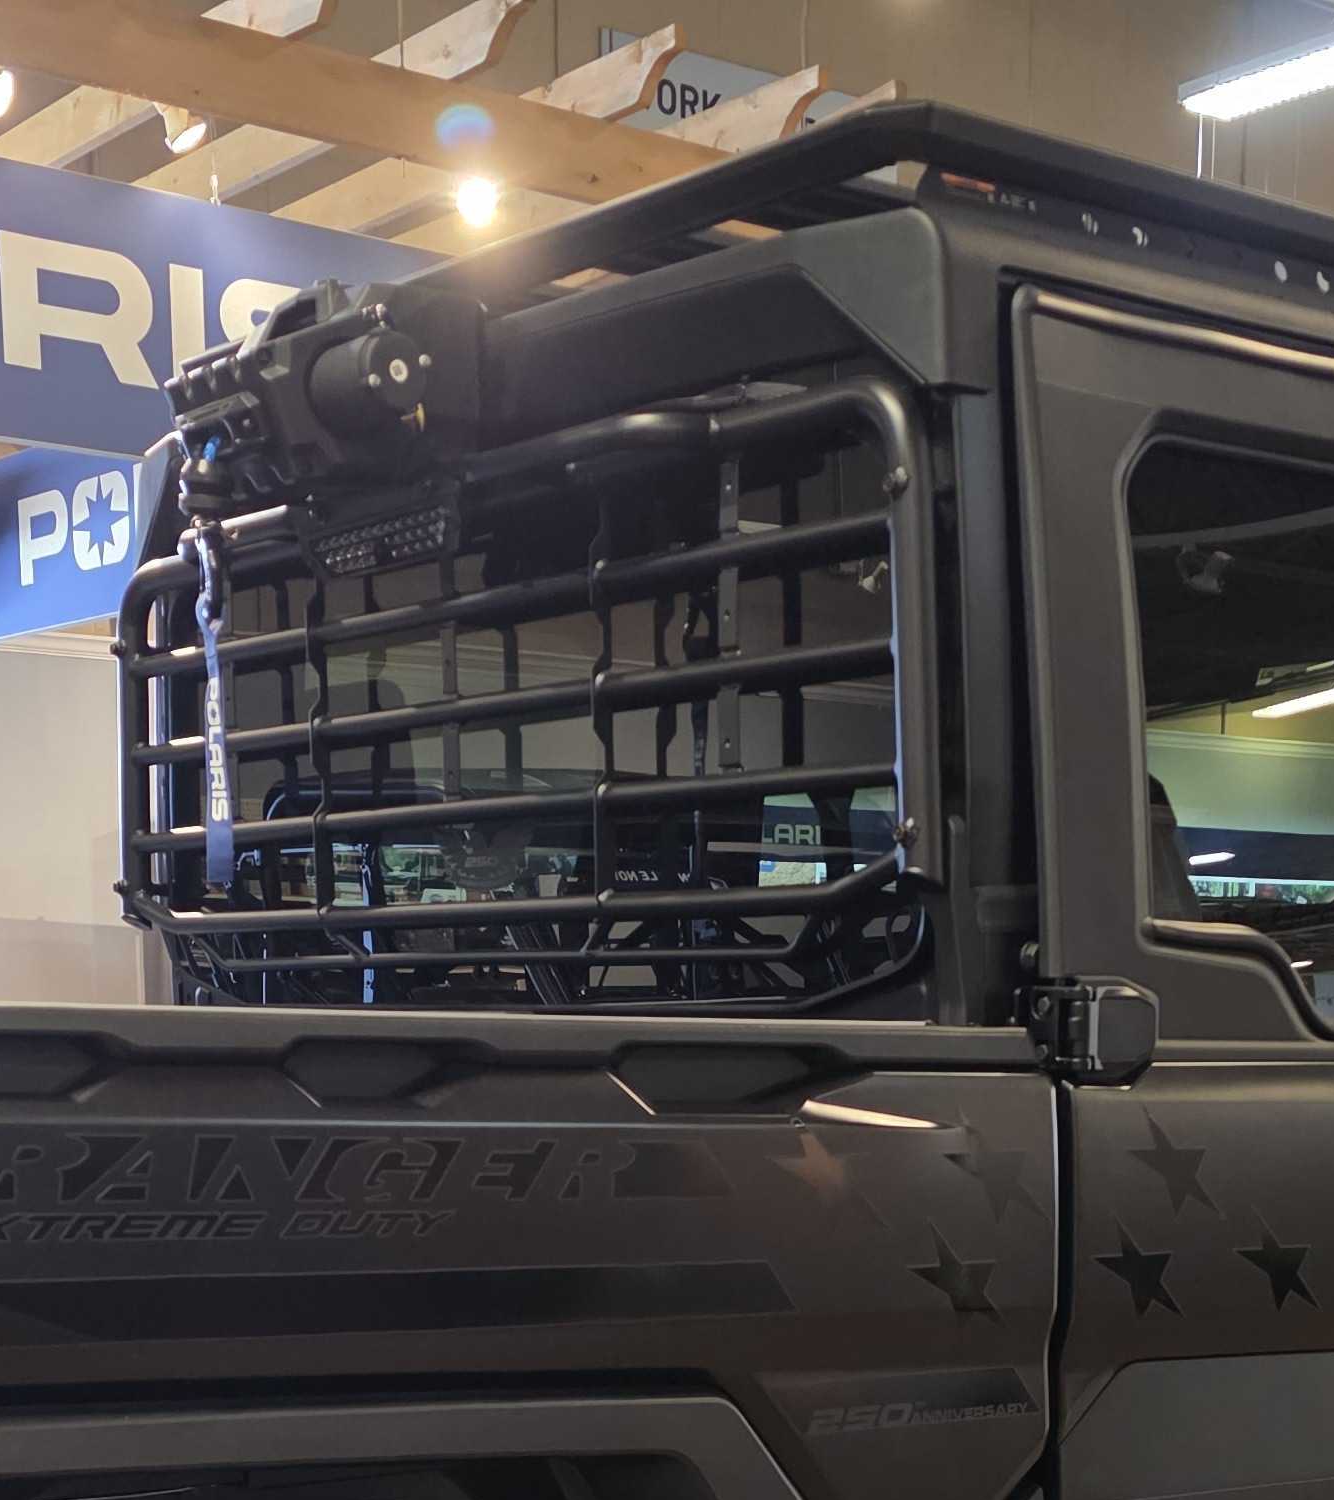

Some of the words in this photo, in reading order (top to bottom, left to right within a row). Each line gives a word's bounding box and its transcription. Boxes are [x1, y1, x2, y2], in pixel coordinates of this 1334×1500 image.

[206, 677, 229, 822] POLARIS
[278, 1208, 453, 1241] DUTY
[909, 1401, 1029, 1426] ANNIVERSARY
